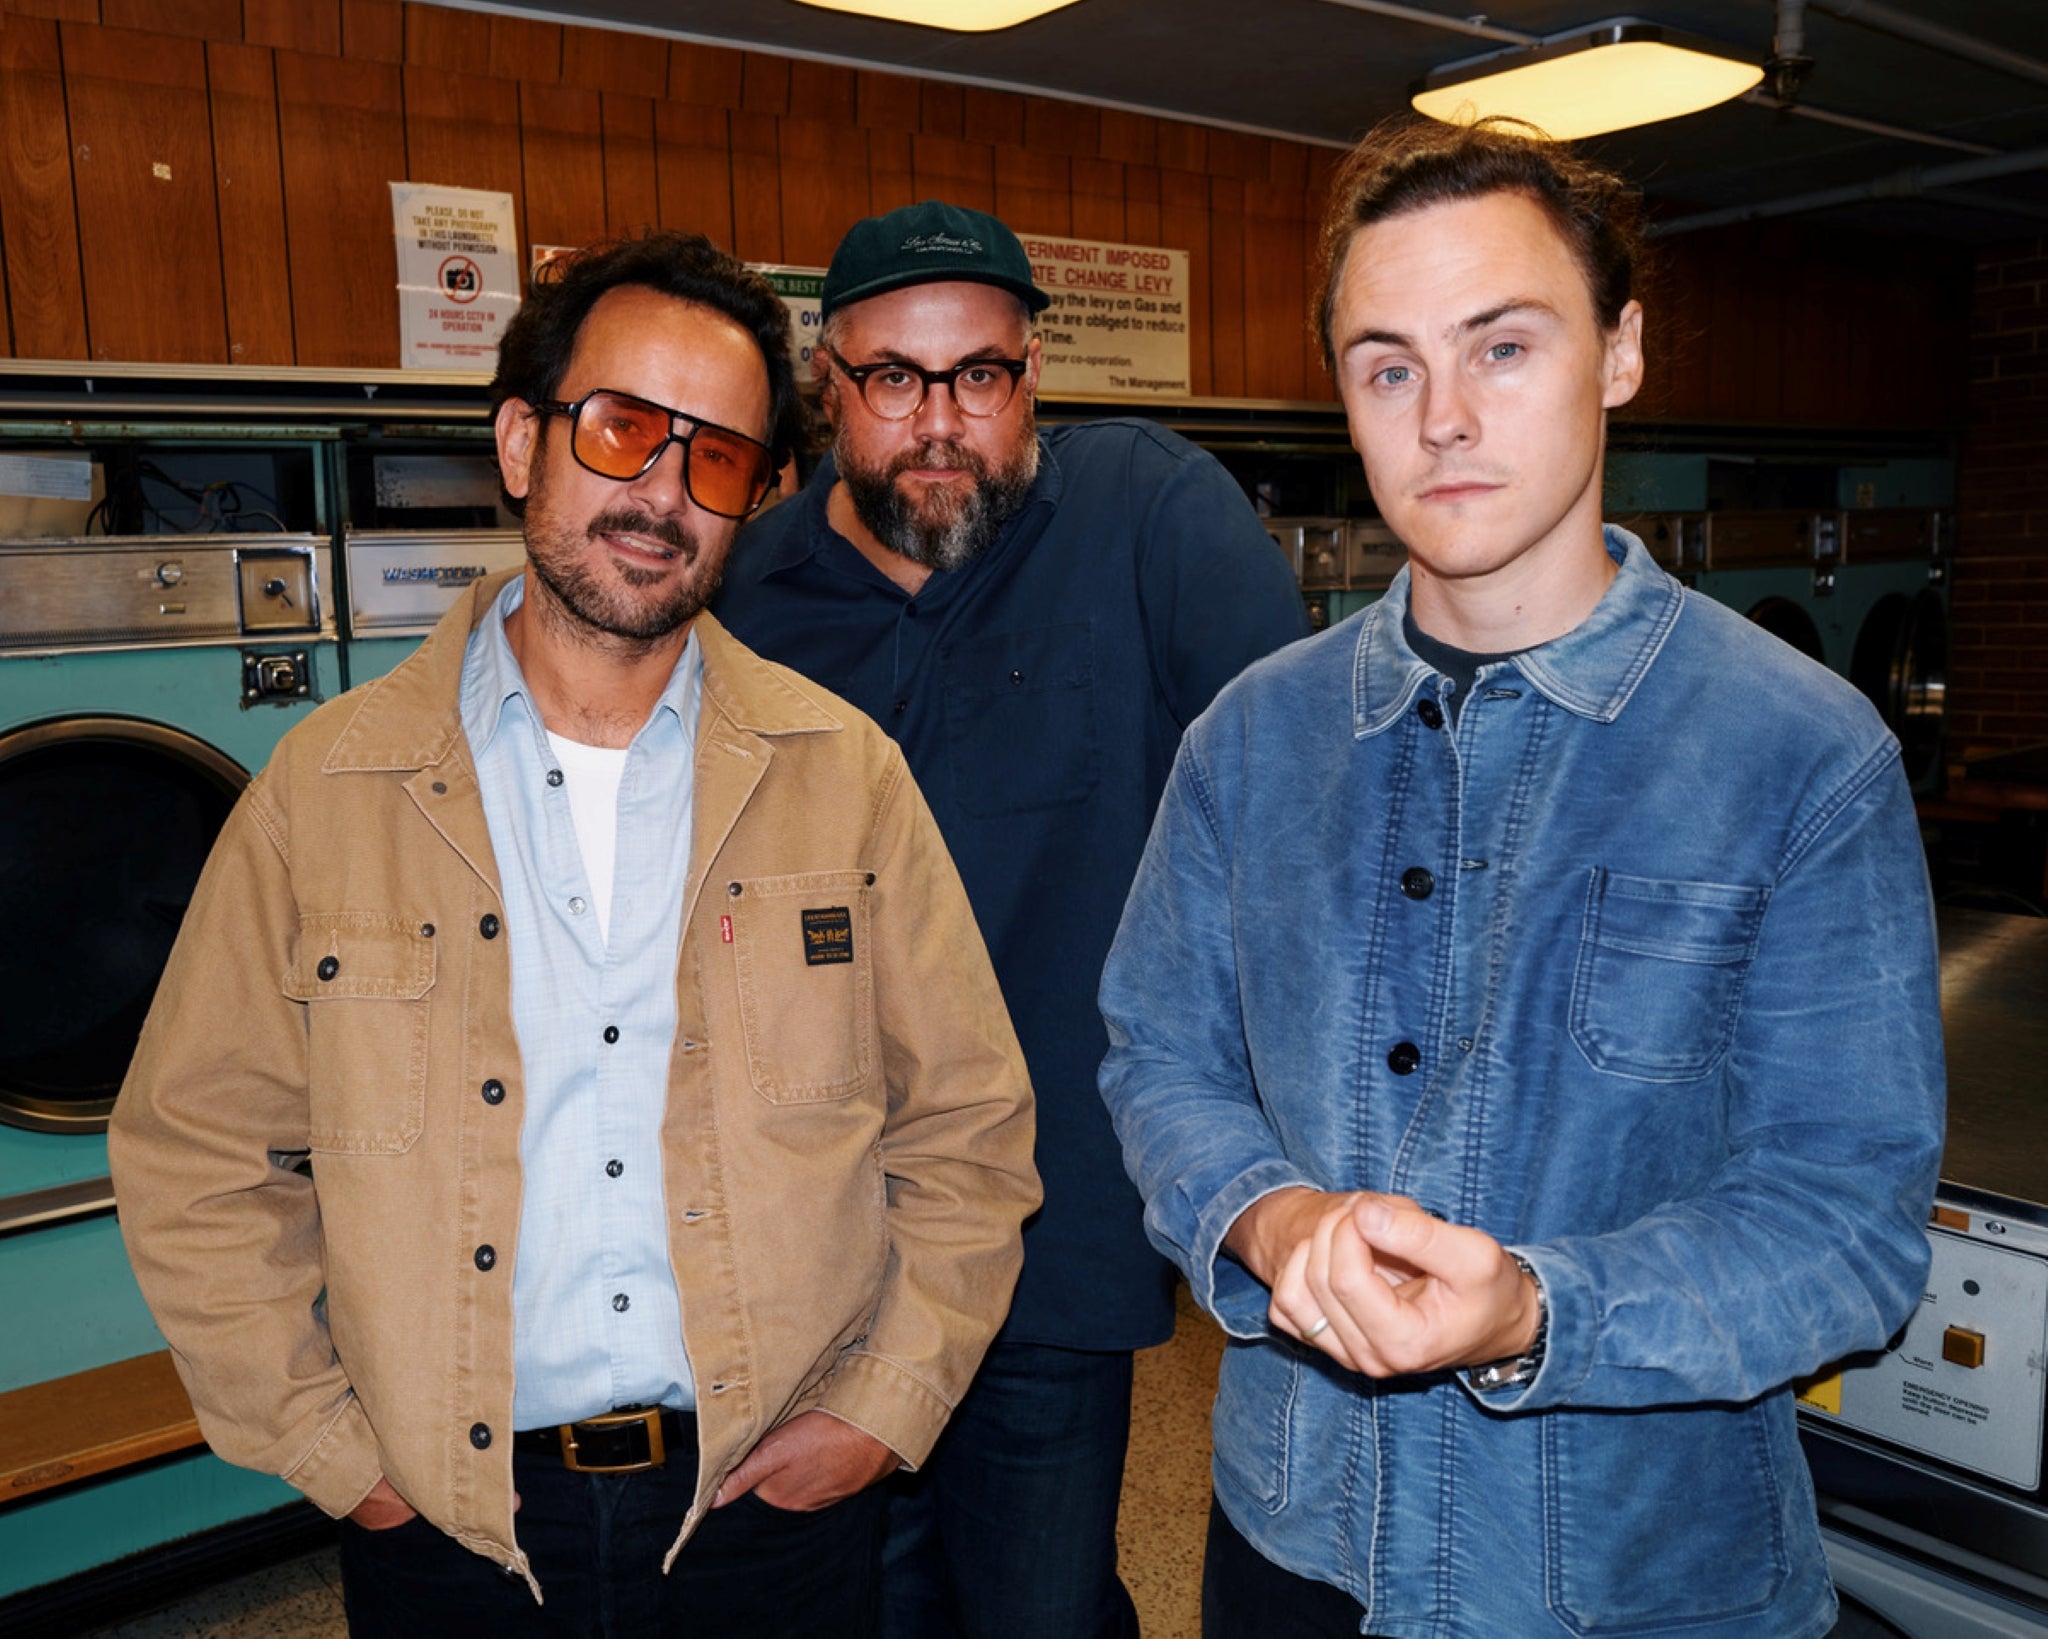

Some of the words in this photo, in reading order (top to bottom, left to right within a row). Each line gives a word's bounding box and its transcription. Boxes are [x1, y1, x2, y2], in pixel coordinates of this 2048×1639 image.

[458, 208, 468, 218] DO
[470, 209, 484, 219] NOT
[413, 215, 431, 226] TAKE
[434, 218, 448, 227] ANY
[451, 219, 498, 231] PHOTOGRAPH
[419, 228, 427, 237] IN
[430, 229, 447, 239] THIS
[417, 239, 450, 251] WITHOUT
[452, 242, 498, 255] PERMISSION
[1106, 249, 1171, 271] IMPOSED
[788, 279, 817, 293] BEST
[1065, 267, 1128, 289] CHANGE
[1134, 274, 1173, 293] LEVY
[1067, 292, 1086, 308] the
[1089, 293, 1114, 312] levy
[1117, 297, 1132, 311] on
[1135, 297, 1157, 313] Gas
[1160, 301, 1182, 315] and
[440, 309, 464, 320] HOURS
[466, 310, 485, 322] CCTV
[487, 311, 495, 322] IN
[1042, 312, 1059, 325] we
[1063, 313, 1082, 327] are
[1086, 313, 1129, 332] obliged
[1132, 317, 1144, 331] to
[1146, 318, 1186, 333] reduce
[442, 321, 483, 333] OPERATION
[1043, 328, 1076, 345] Time.
[1045, 353, 1068, 366] your
[1109, 375, 1126, 388] The
[1128, 376, 1187, 391] Management
[1903, 1380, 1952, 1401] EMERGENCY
[1953, 1397, 1990, 1414] OPENING
